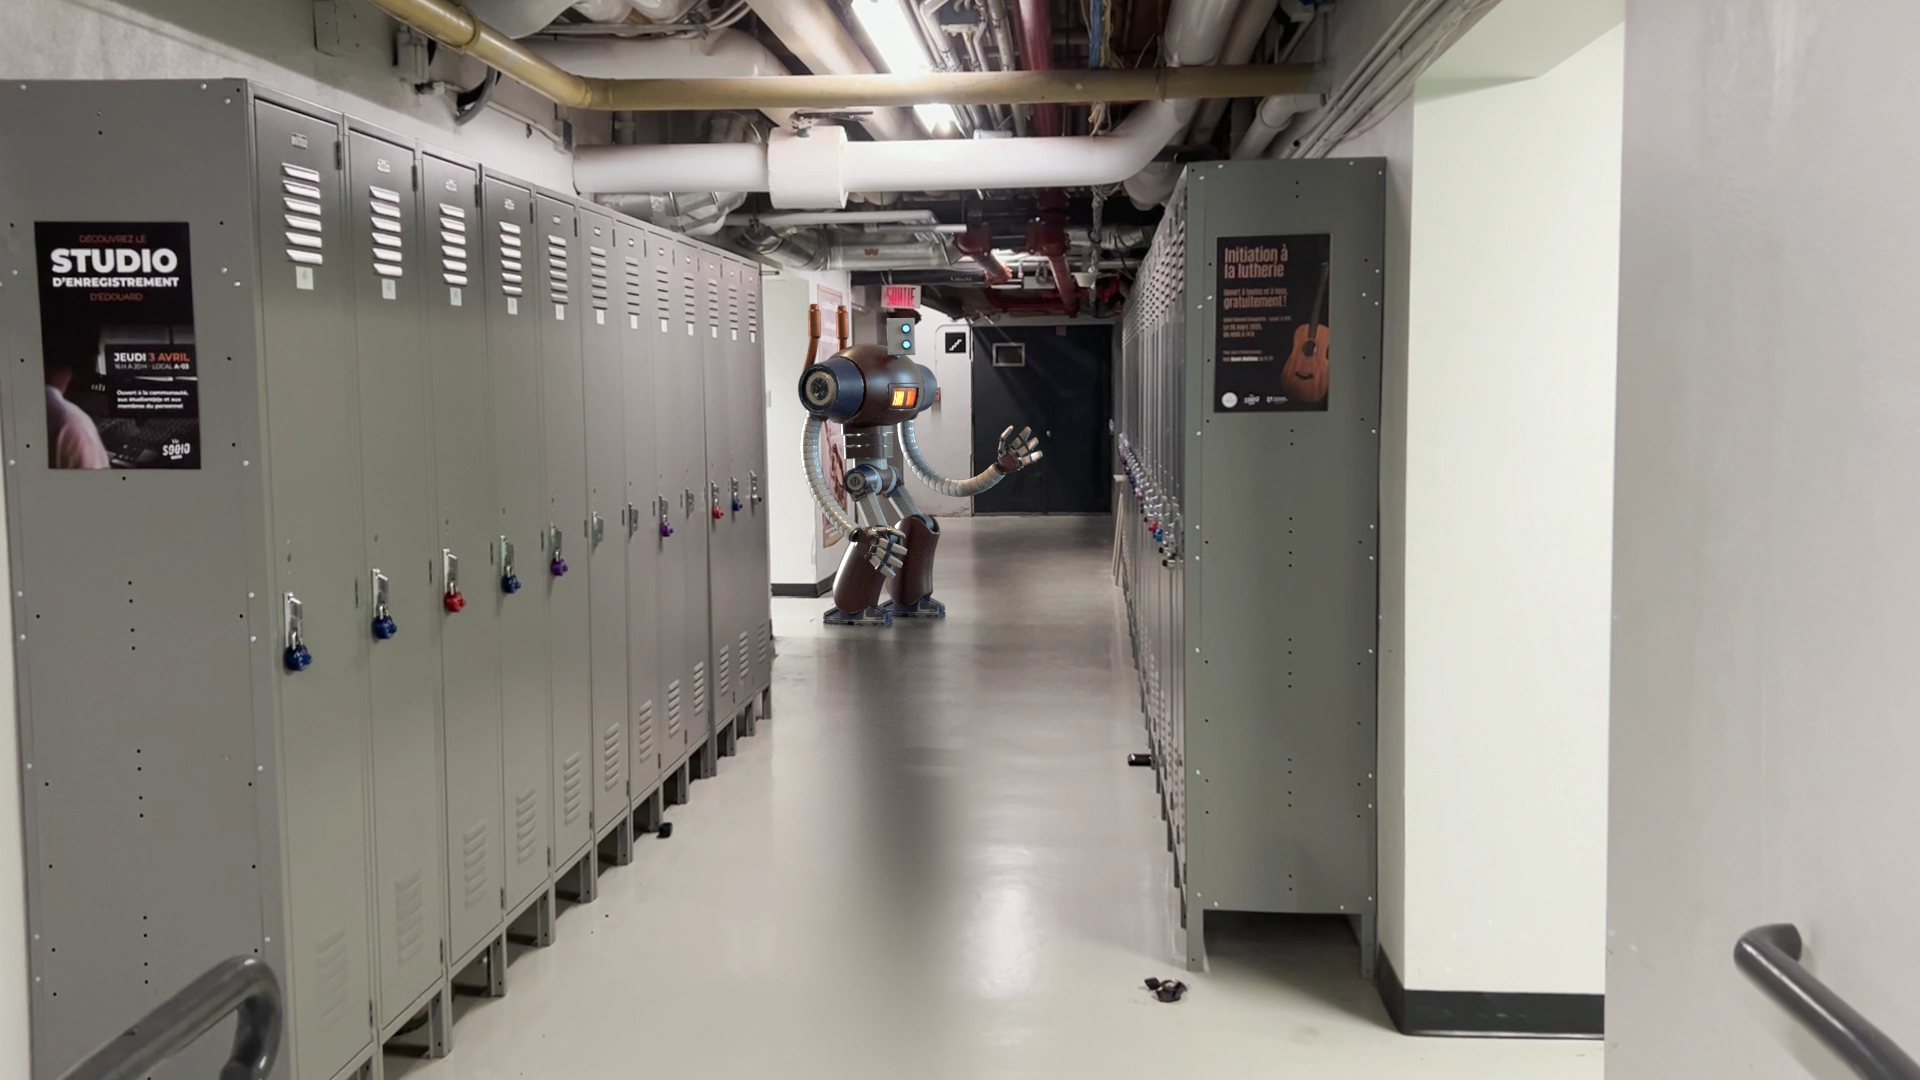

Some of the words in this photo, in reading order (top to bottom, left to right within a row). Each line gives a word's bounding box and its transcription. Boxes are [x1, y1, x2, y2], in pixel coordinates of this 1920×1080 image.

[79, 234, 133, 243] DÉCOUVREZ
[136, 235, 146, 243] LE
[51, 248, 178, 273] STUDIO
[1225, 246, 1278, 263] Initiation
[1280, 244, 1288, 262] à
[1225, 264, 1235, 279] la
[1238, 261, 1284, 278] lutherie
[885, 287, 916, 306] SORTIE
[1223, 295, 1282, 310] gratuitement
[114, 353, 147, 362] JEUDI
[149, 353, 156, 362] 3
[158, 353, 190, 362] AVRIL
